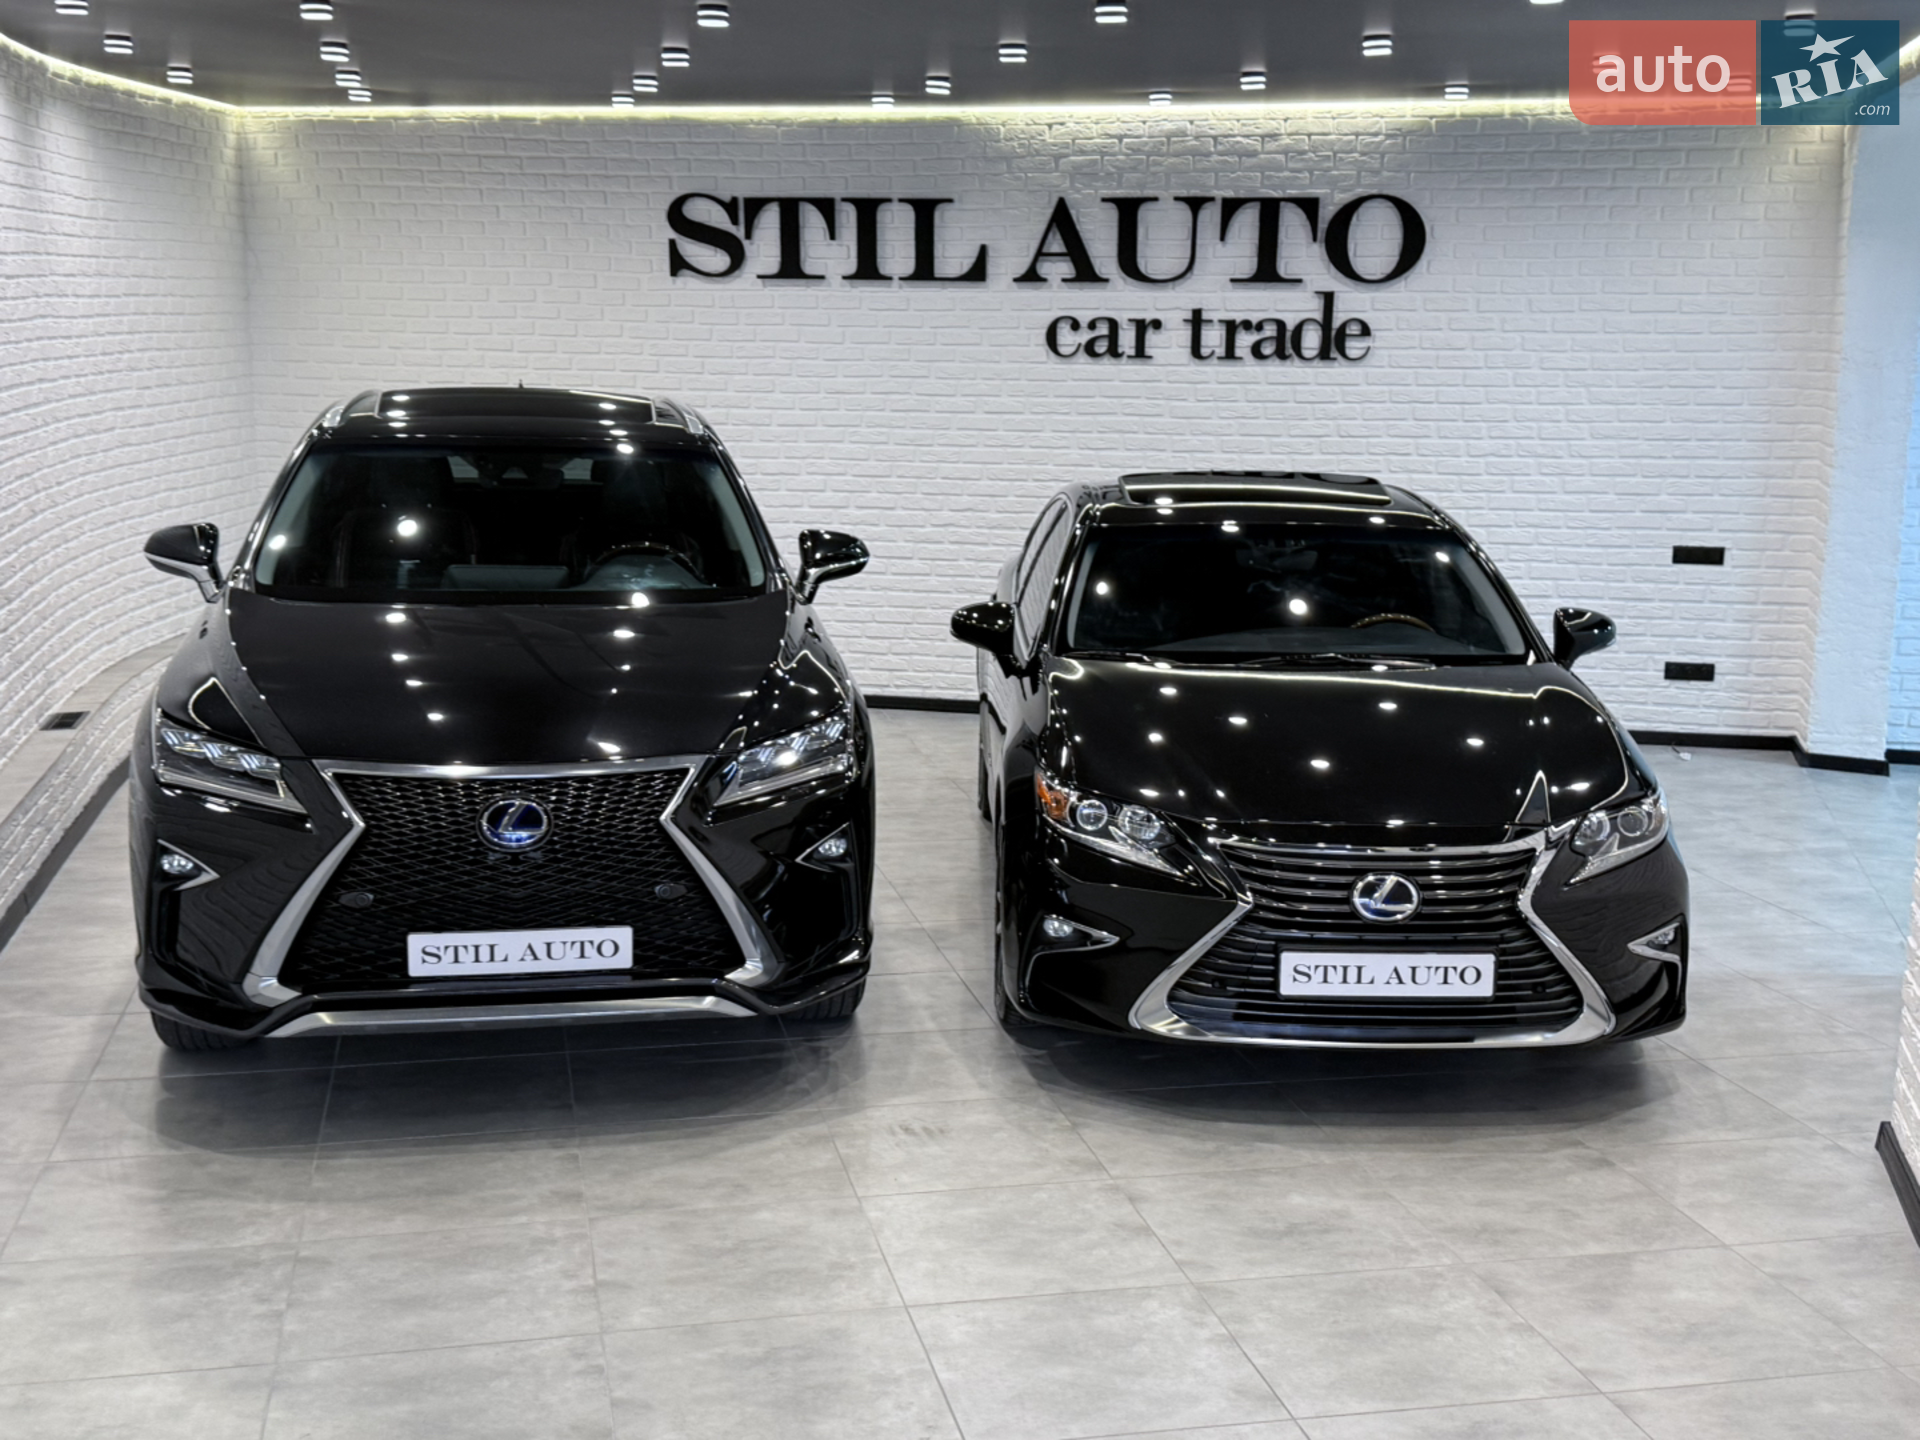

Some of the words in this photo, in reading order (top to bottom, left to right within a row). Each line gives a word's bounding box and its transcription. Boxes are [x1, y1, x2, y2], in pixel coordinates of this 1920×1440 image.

[666, 192, 988, 282] STIL
[1012, 193, 1427, 285] AUTO
[1045, 314, 1162, 360] car
[1184, 291, 1372, 362] trade
[421, 944, 509, 965] STIL
[518, 938, 620, 962] AUTO
[1292, 963, 1375, 985] STIL
[1383, 965, 1482, 985] AUTO
